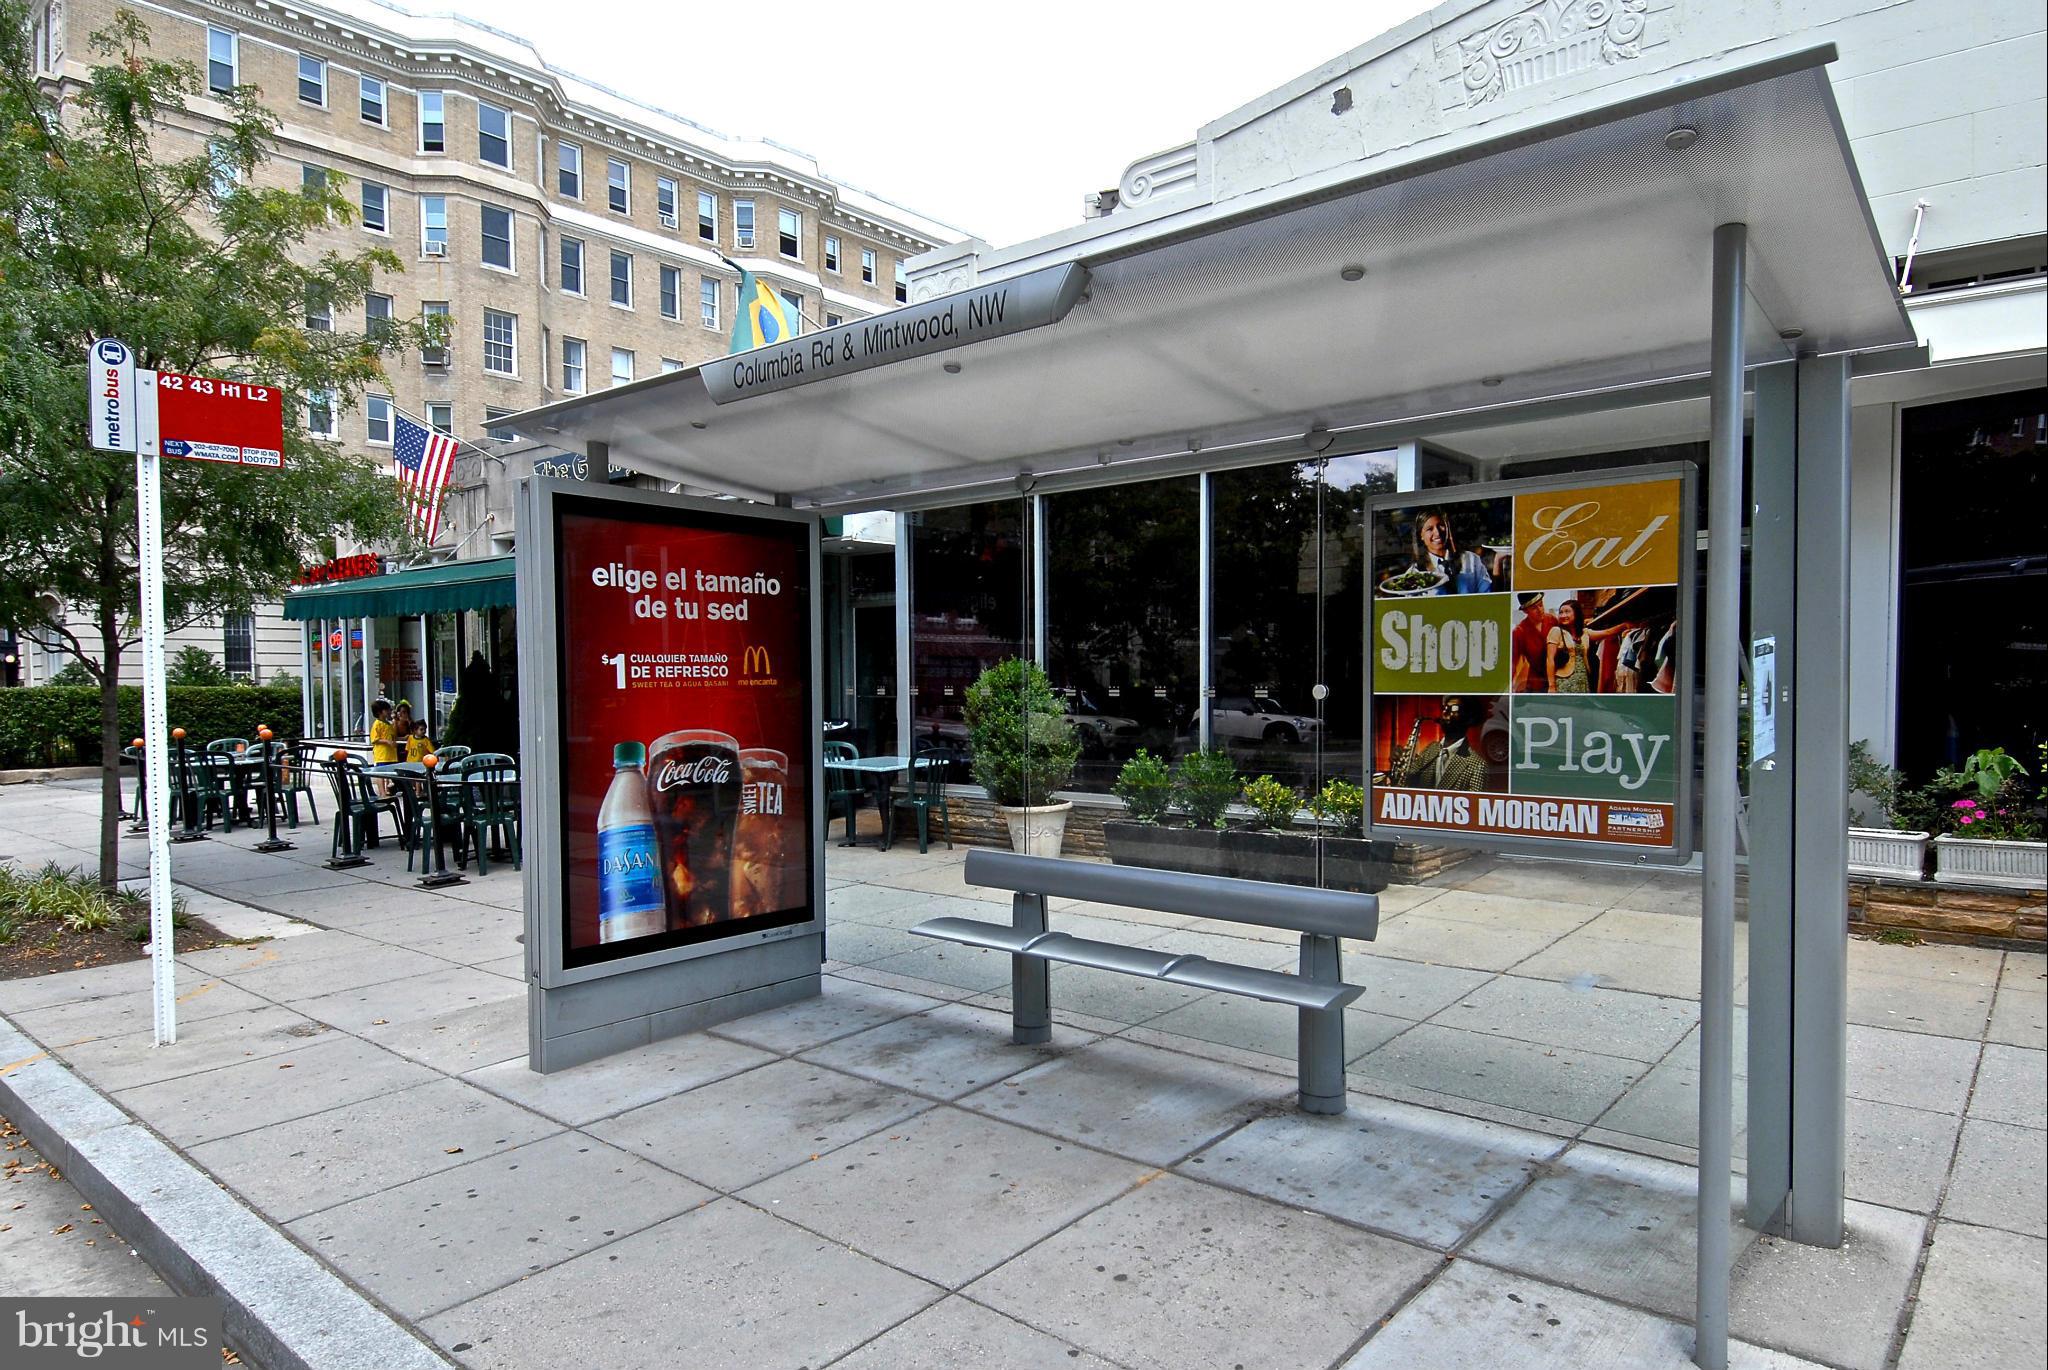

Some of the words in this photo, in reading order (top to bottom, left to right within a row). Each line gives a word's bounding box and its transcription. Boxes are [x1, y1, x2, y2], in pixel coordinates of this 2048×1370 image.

[733, 350, 803, 389] Columbia
[811, 336, 835, 369] Rd
[842, 333, 855, 361] &
[863, 304, 959, 357] Mintwood,
[967, 289, 1008, 331] NW
[160, 375, 183, 391] 42
[190, 378, 214, 394] 43
[220, 383, 240, 398] H1
[247, 387, 268, 402] L2
[104, 368, 120, 447] metrobus
[164, 440, 184, 448] NEXT
[167, 447, 183, 455] BUS
[194, 450, 239, 461] WMATA.COM
[243, 448, 259, 456] STOP
[260, 449, 268, 457] ID
[244, 455, 278, 465] 1001779
[1523, 501, 1670, 572] Eat
[592, 563, 657, 593] elige
[665, 568, 686, 590] el
[695, 570, 781, 596] tamaño
[635, 595, 667, 619] de
[675, 597, 699, 619] tu
[707, 599, 748, 621] sed
[630, 654, 687, 663] CUALQUIER
[689, 652, 729, 663] TAMAÑO
[1380, 609, 1499, 678] Shop
[631, 666, 651, 678] DE
[655, 665, 729, 678] REFRESCO
[1515, 716, 1670, 790] Play
[656, 756, 732, 792] Coca-Cola
[742, 783, 757, 815] SWEET
[758, 782, 783, 815] TEA
[1381, 792, 1470, 825] ADAMS
[1478, 798, 1599, 835] MORGAN
[1608, 826, 1660, 834] PARTNERSHIP
